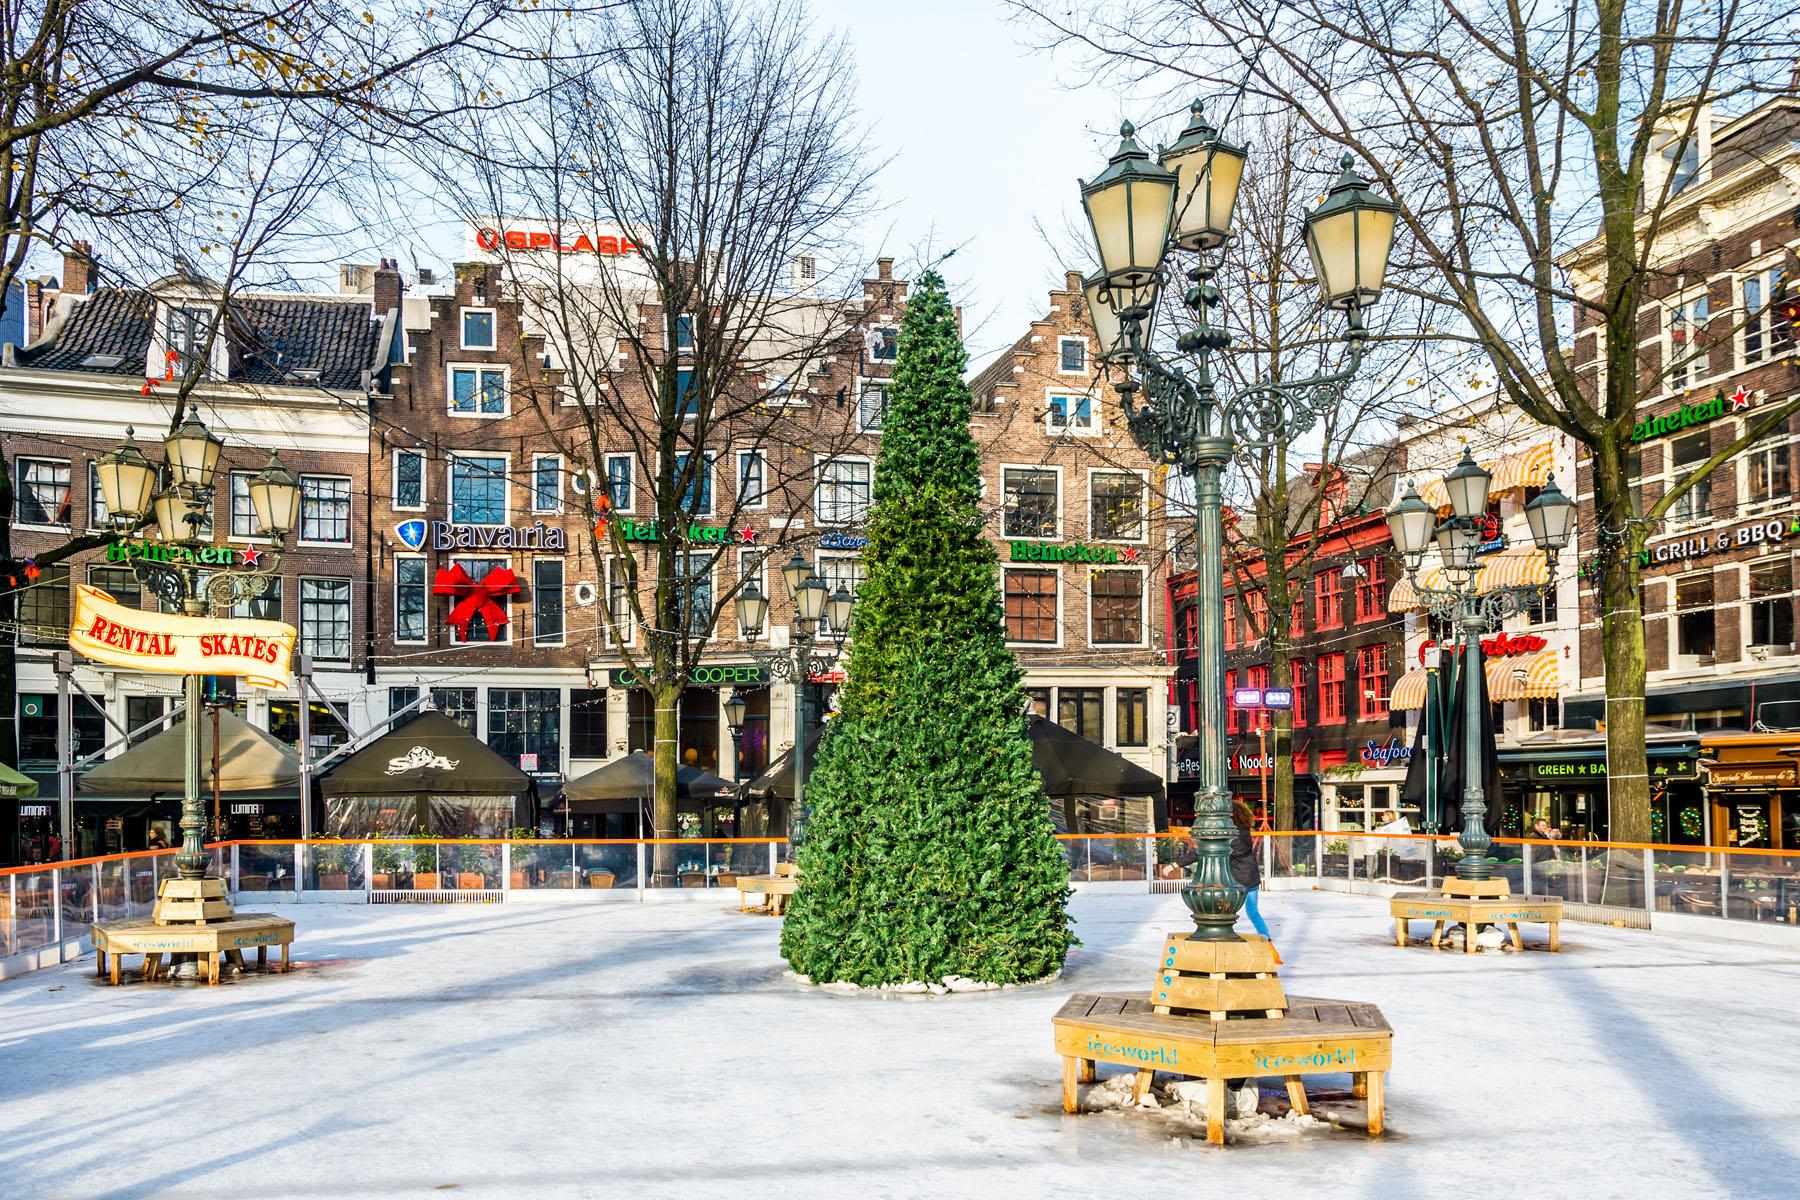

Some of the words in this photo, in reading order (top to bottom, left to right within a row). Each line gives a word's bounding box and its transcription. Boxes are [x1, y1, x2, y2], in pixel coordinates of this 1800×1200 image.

[505, 231, 644, 256] SPLASH
[1632, 397, 1724, 441] eineken
[432, 520, 565, 549] Bavaria
[1656, 537, 1709, 562] GRILL
[1717, 532, 1730, 549] &
[1737, 520, 1783, 546] BBQ
[1010, 540, 1118, 562] Heineken
[89, 616, 176, 656] RENTAL
[200, 633, 279, 664] SKATES
[386, 752, 456, 774] SPA
[1538, 764, 1574, 775] GREEN
[1590, 763, 1607, 774] BA
[1088, 1037, 1178, 1065] ice-world
[1255, 1047, 1356, 1070] ice-world
